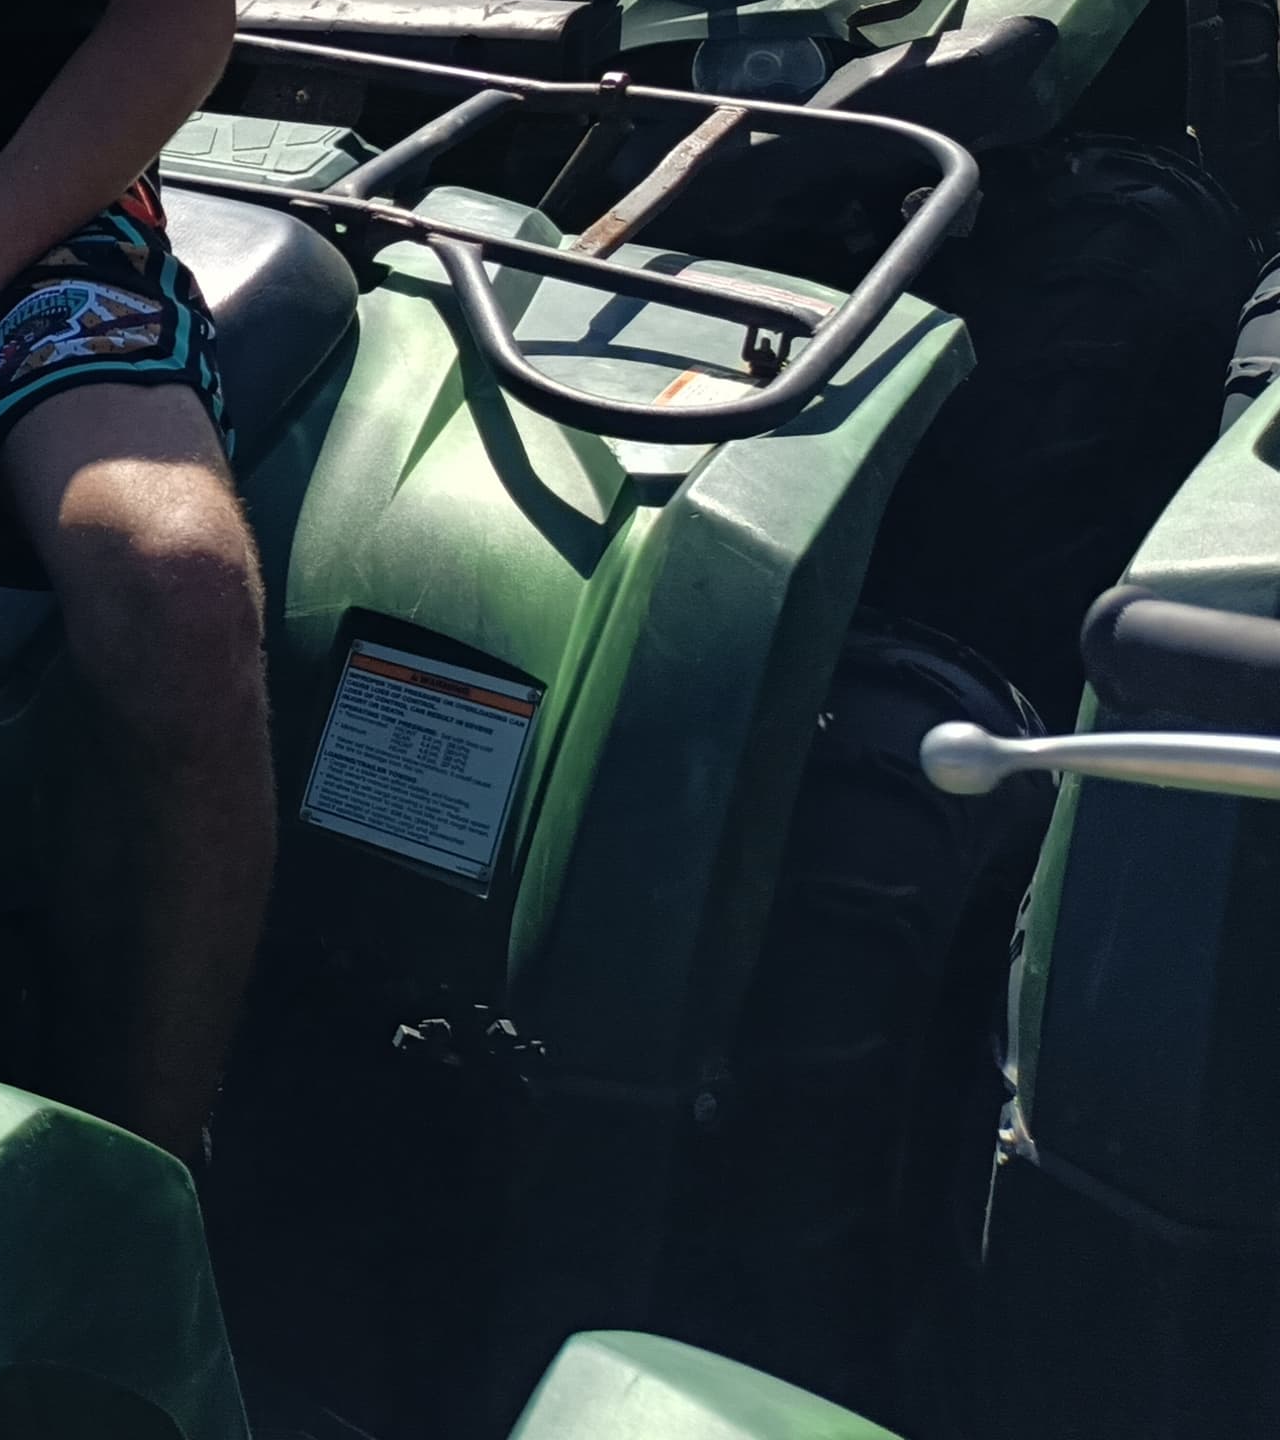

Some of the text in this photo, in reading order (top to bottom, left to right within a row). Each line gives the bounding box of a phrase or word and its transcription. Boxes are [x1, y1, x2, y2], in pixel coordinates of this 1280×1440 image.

[454, 701, 508, 723] OVERLOADING
[508, 718, 526, 728] CAN
[387, 769, 417, 784] TOWING
